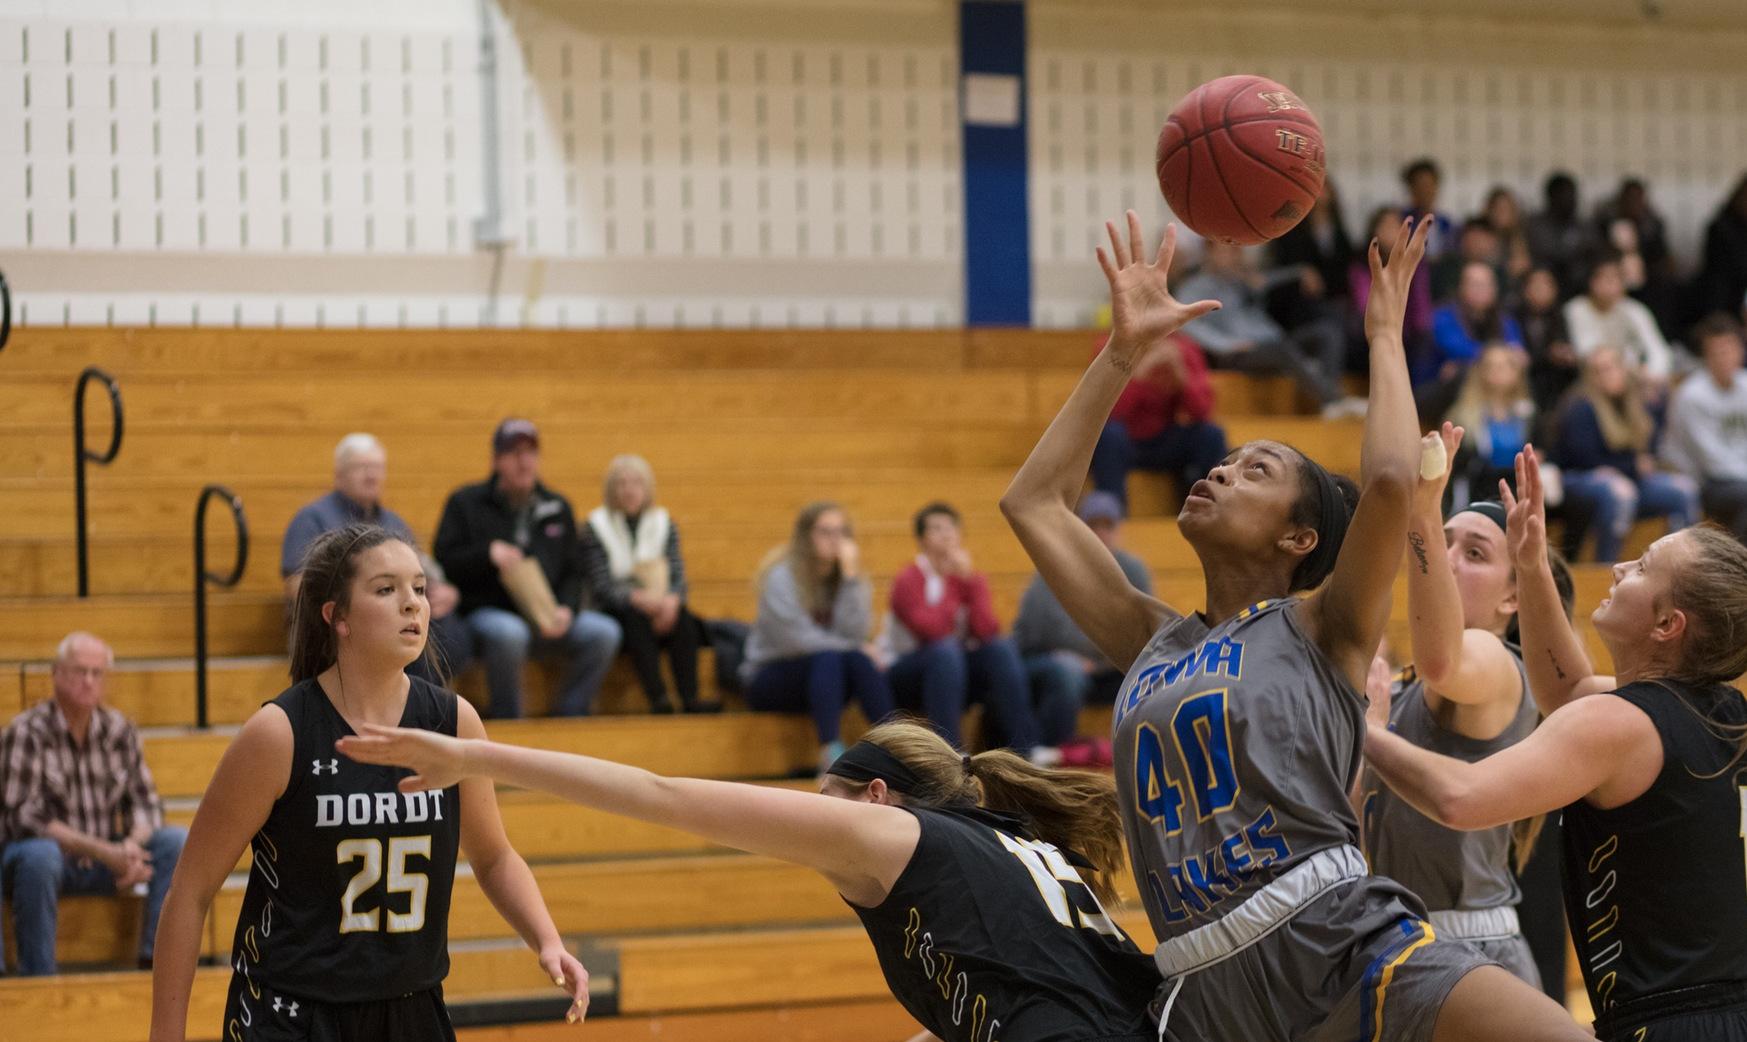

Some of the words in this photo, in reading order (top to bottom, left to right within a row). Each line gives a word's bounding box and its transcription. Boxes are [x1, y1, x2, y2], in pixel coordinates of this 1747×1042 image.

[315, 788, 444, 827] DORDT
[1134, 687, 1241, 837] 40
[336, 834, 432, 934] 25
[1149, 804, 1293, 924] LAKES
